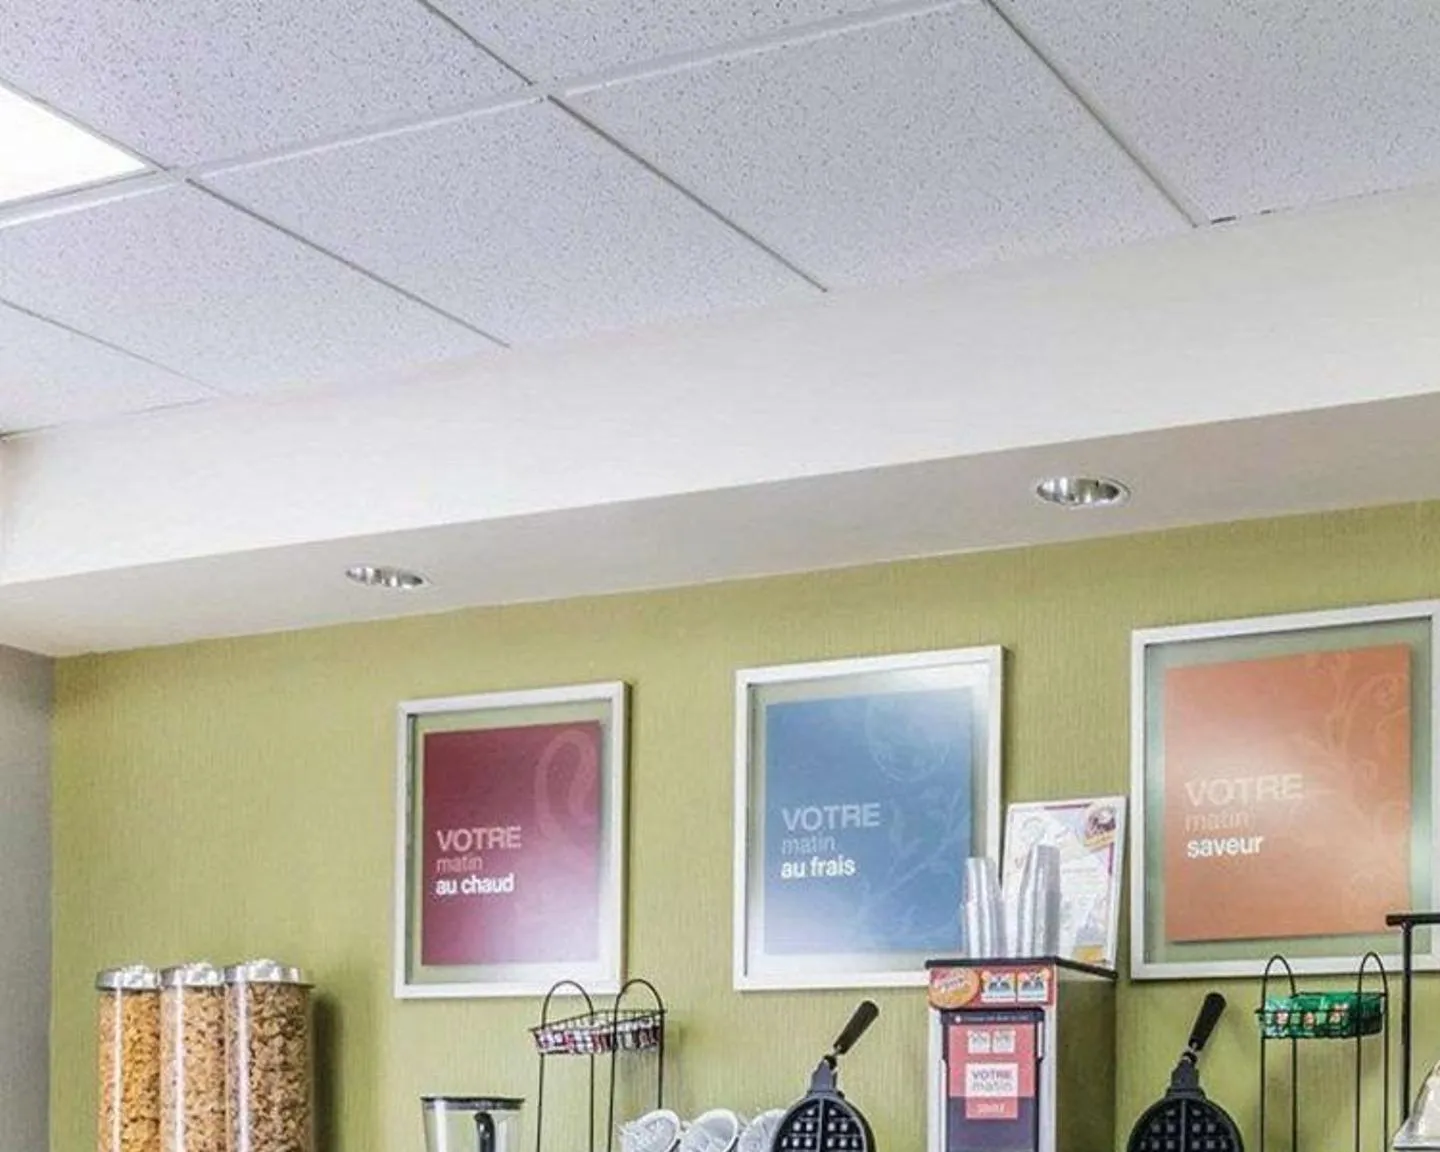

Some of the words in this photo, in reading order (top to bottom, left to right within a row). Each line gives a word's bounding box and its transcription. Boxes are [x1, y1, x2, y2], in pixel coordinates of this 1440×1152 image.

[1184, 773, 1303, 807] VOTRE
[781, 803, 880, 831] VOTRE
[1185, 808, 1250, 832] matin
[436, 826, 522, 852] VOTRE
[782, 834, 836, 854] matin
[1187, 836, 1264, 858] saveur
[437, 854, 483, 873] matin
[781, 861, 806, 878] au
[810, 854, 857, 877] frais
[436, 879, 458, 895] au
[461, 872, 515, 894] chaud
[971, 1069, 1013, 1082] VOTRE
[971, 1079, 1013, 1093] matin
